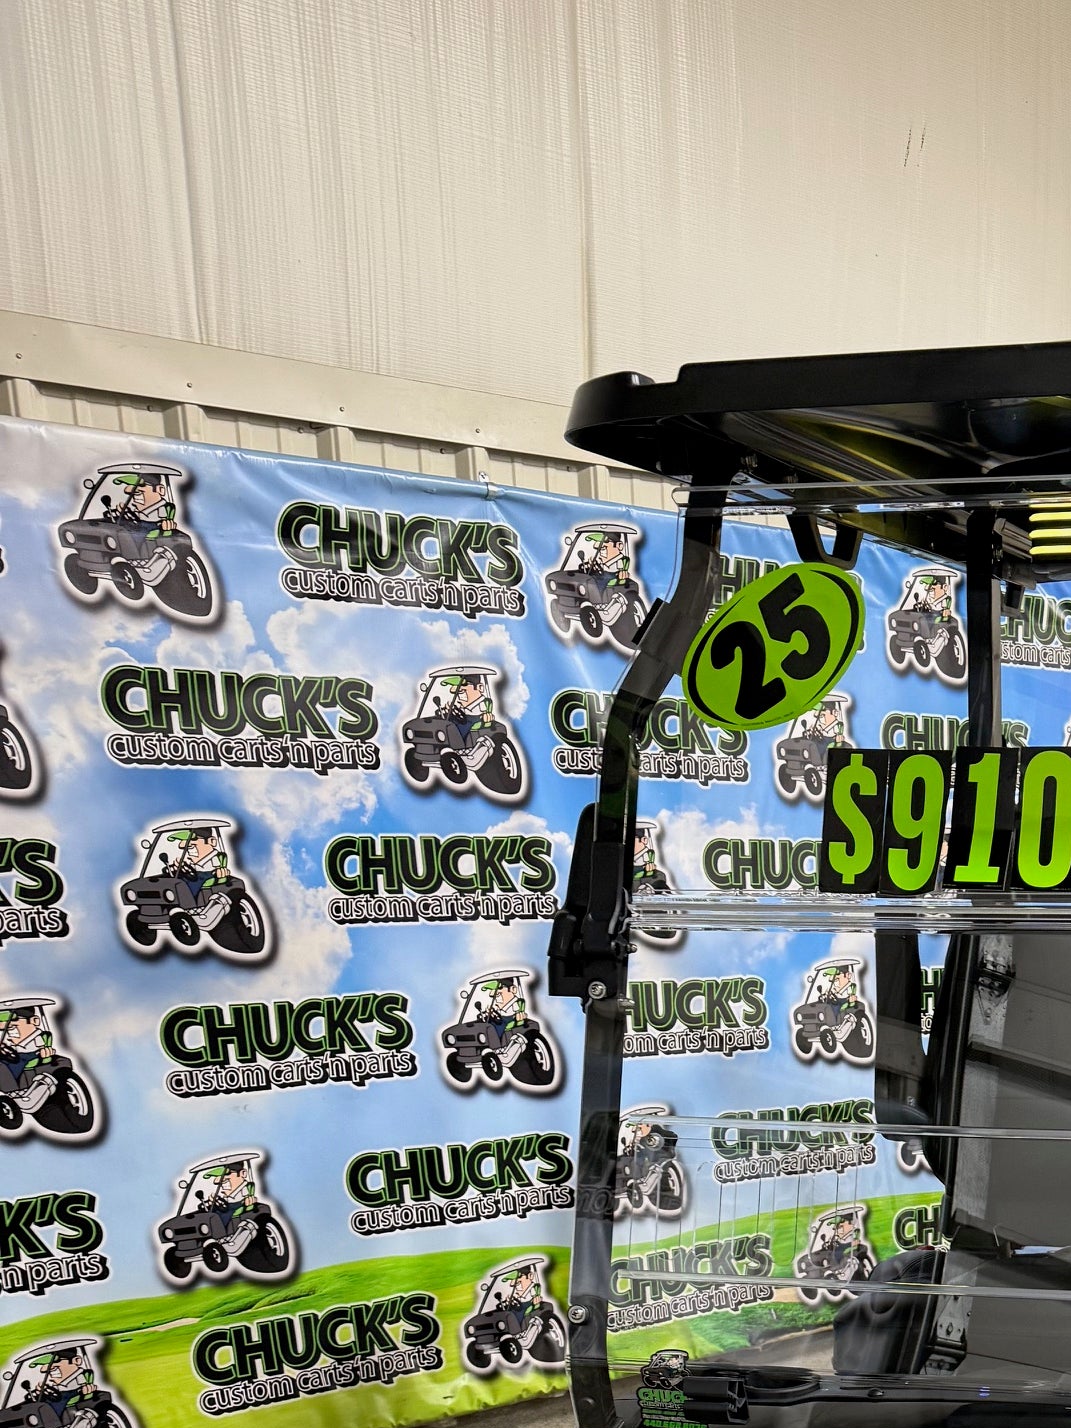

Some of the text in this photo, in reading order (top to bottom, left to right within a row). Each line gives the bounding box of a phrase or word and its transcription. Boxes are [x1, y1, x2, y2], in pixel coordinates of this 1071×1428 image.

[278, 502, 523, 586] CHUCK'S
[282, 568, 379, 600] custom
[462, 584, 522, 614] parts
[711, 572, 830, 719] 25
[1001, 640, 1038, 664] stom
[101, 664, 378, 740] CHUCK'S
[108, 734, 218, 764] custom
[312, 739, 379, 773] parts
[555, 748, 602, 772] cust
[698, 754, 746, 782] parts
[325, 835, 556, 893] CHUCK'S
[703, 838, 820, 889] CHUC
[0, 906, 65, 939] arts
[329, 895, 416, 922] custom
[499, 894, 556, 923] parts
[160, 993, 413, 1066] CHUCK'S
[628, 978, 767, 1032] HUCK'S
[723, 1026, 766, 1054] parts
[166, 1065, 270, 1096] custom
[351, 1051, 415, 1085] parts
[711, 1099, 875, 1160] CHUCK'S
[346, 1133, 573, 1206] CHUCK'S
[714, 1155, 778, 1182] custom
[837, 1143, 875, 1170] parts
[351, 1202, 444, 1234] custom
[516, 1186, 573, 1216] parts
[25, 1253, 108, 1294] parts
[610, 1234, 773, 1307] CHUCK'S
[606, 1301, 670, 1331] custom
[728, 1284, 772, 1311] parts
[193, 1293, 440, 1385] CHUCK'S
[200, 1376, 298, 1414] custom
[379, 1346, 442, 1383] parts
